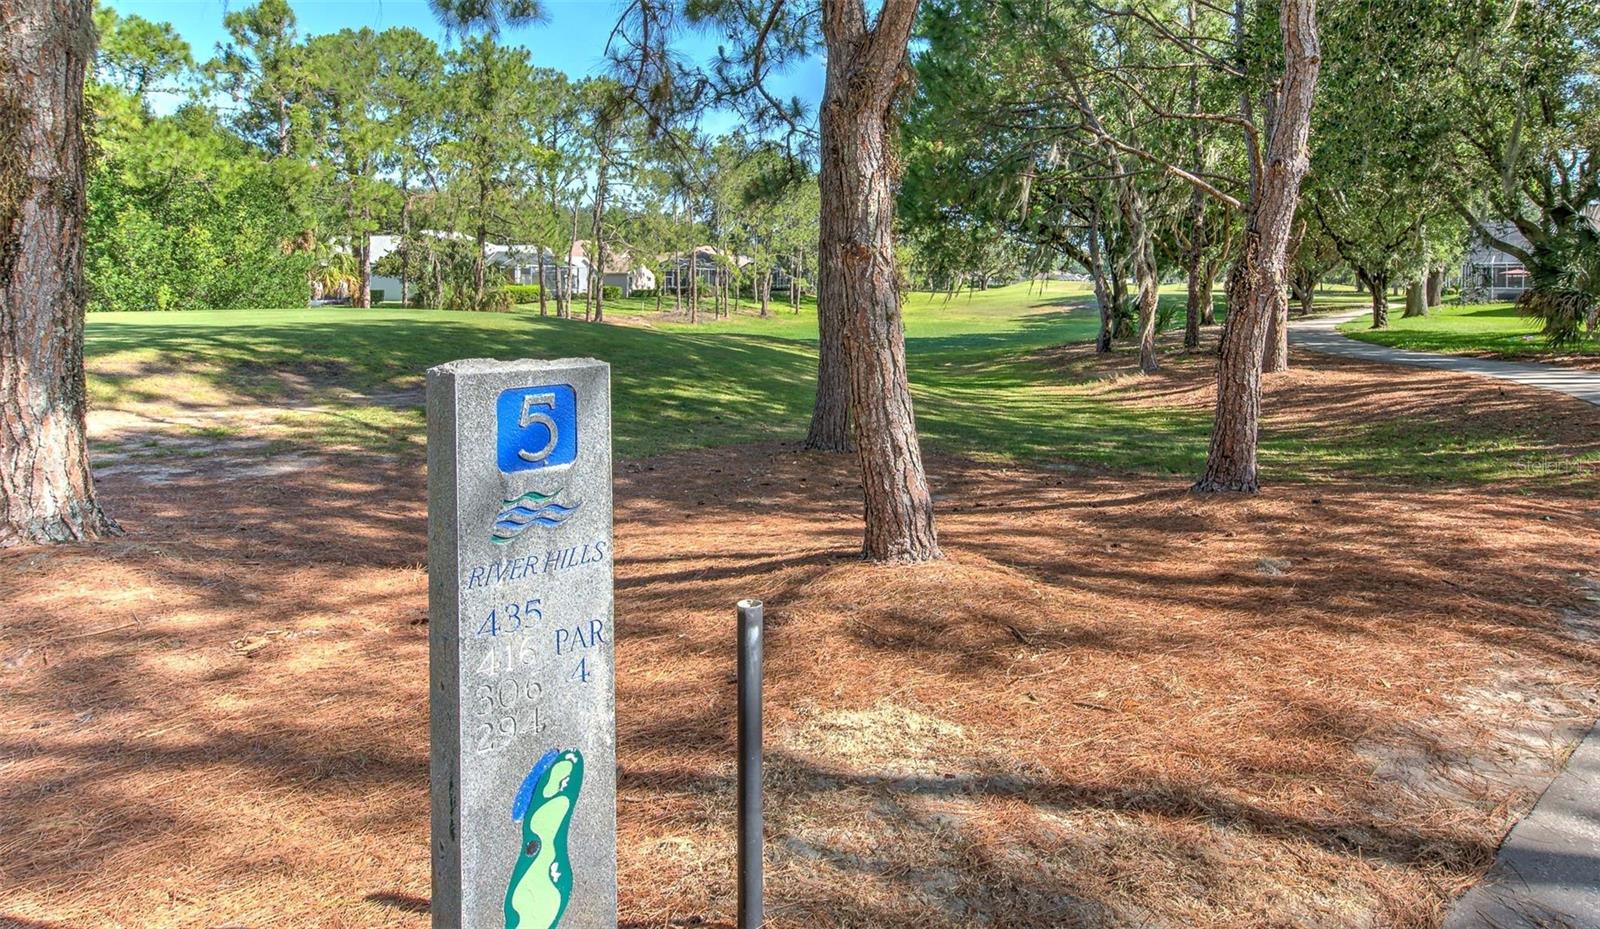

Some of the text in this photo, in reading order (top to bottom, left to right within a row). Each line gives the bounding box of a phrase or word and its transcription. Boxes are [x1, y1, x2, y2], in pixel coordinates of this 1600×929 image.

[517, 392, 558, 463] 5
[468, 541, 606, 590] RIVER HILLS
[477, 599, 542, 637] 435
[555, 619, 605, 655] PAR
[476, 636, 537, 676] 416
[571, 656, 591, 683] 4
[477, 707, 547, 753] 294
